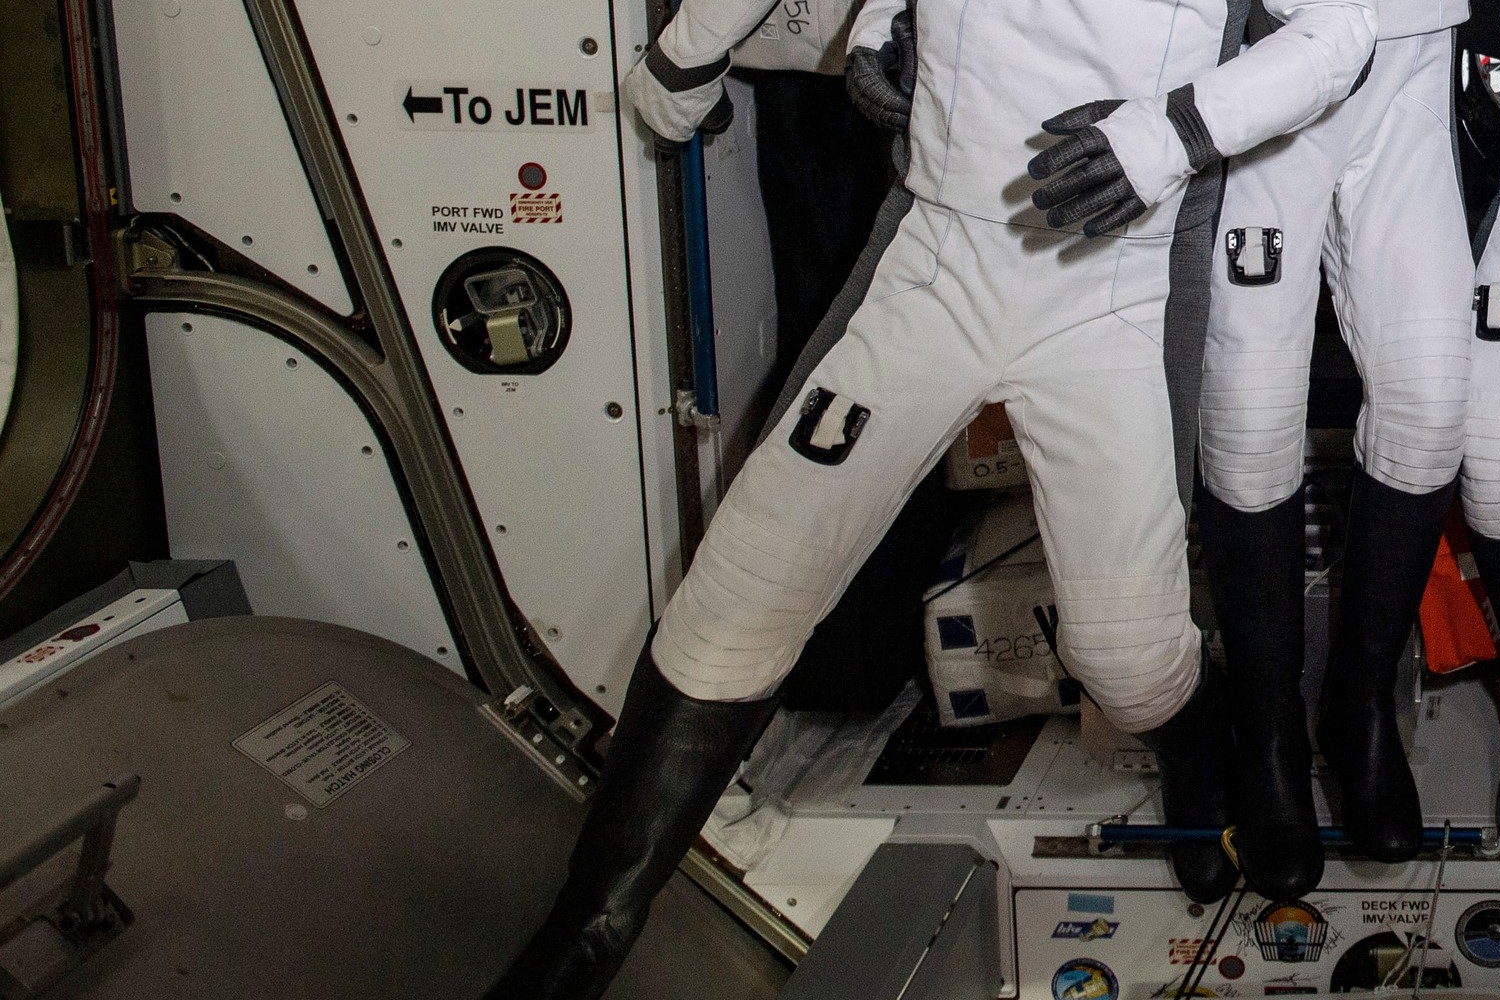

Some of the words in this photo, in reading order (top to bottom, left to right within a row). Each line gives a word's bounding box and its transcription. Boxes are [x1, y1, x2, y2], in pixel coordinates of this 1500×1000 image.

[443, 87, 492, 125] To
[505, 88, 588, 126] JEM
[432, 206, 469, 218] PORT
[473, 207, 504, 219] FWD
[433, 221, 457, 232] IMV
[461, 222, 504, 234] VALVE
[974, 637, 1051, 662] 4265
[353, 744, 392, 774] CLOSING
[322, 769, 358, 795] HATCH
[1362, 900, 1397, 911] DECK
[1401, 901, 1430, 911] FWD
[1362, 914, 1384, 924] IMV
[1388, 914, 1429, 924] VALVE
